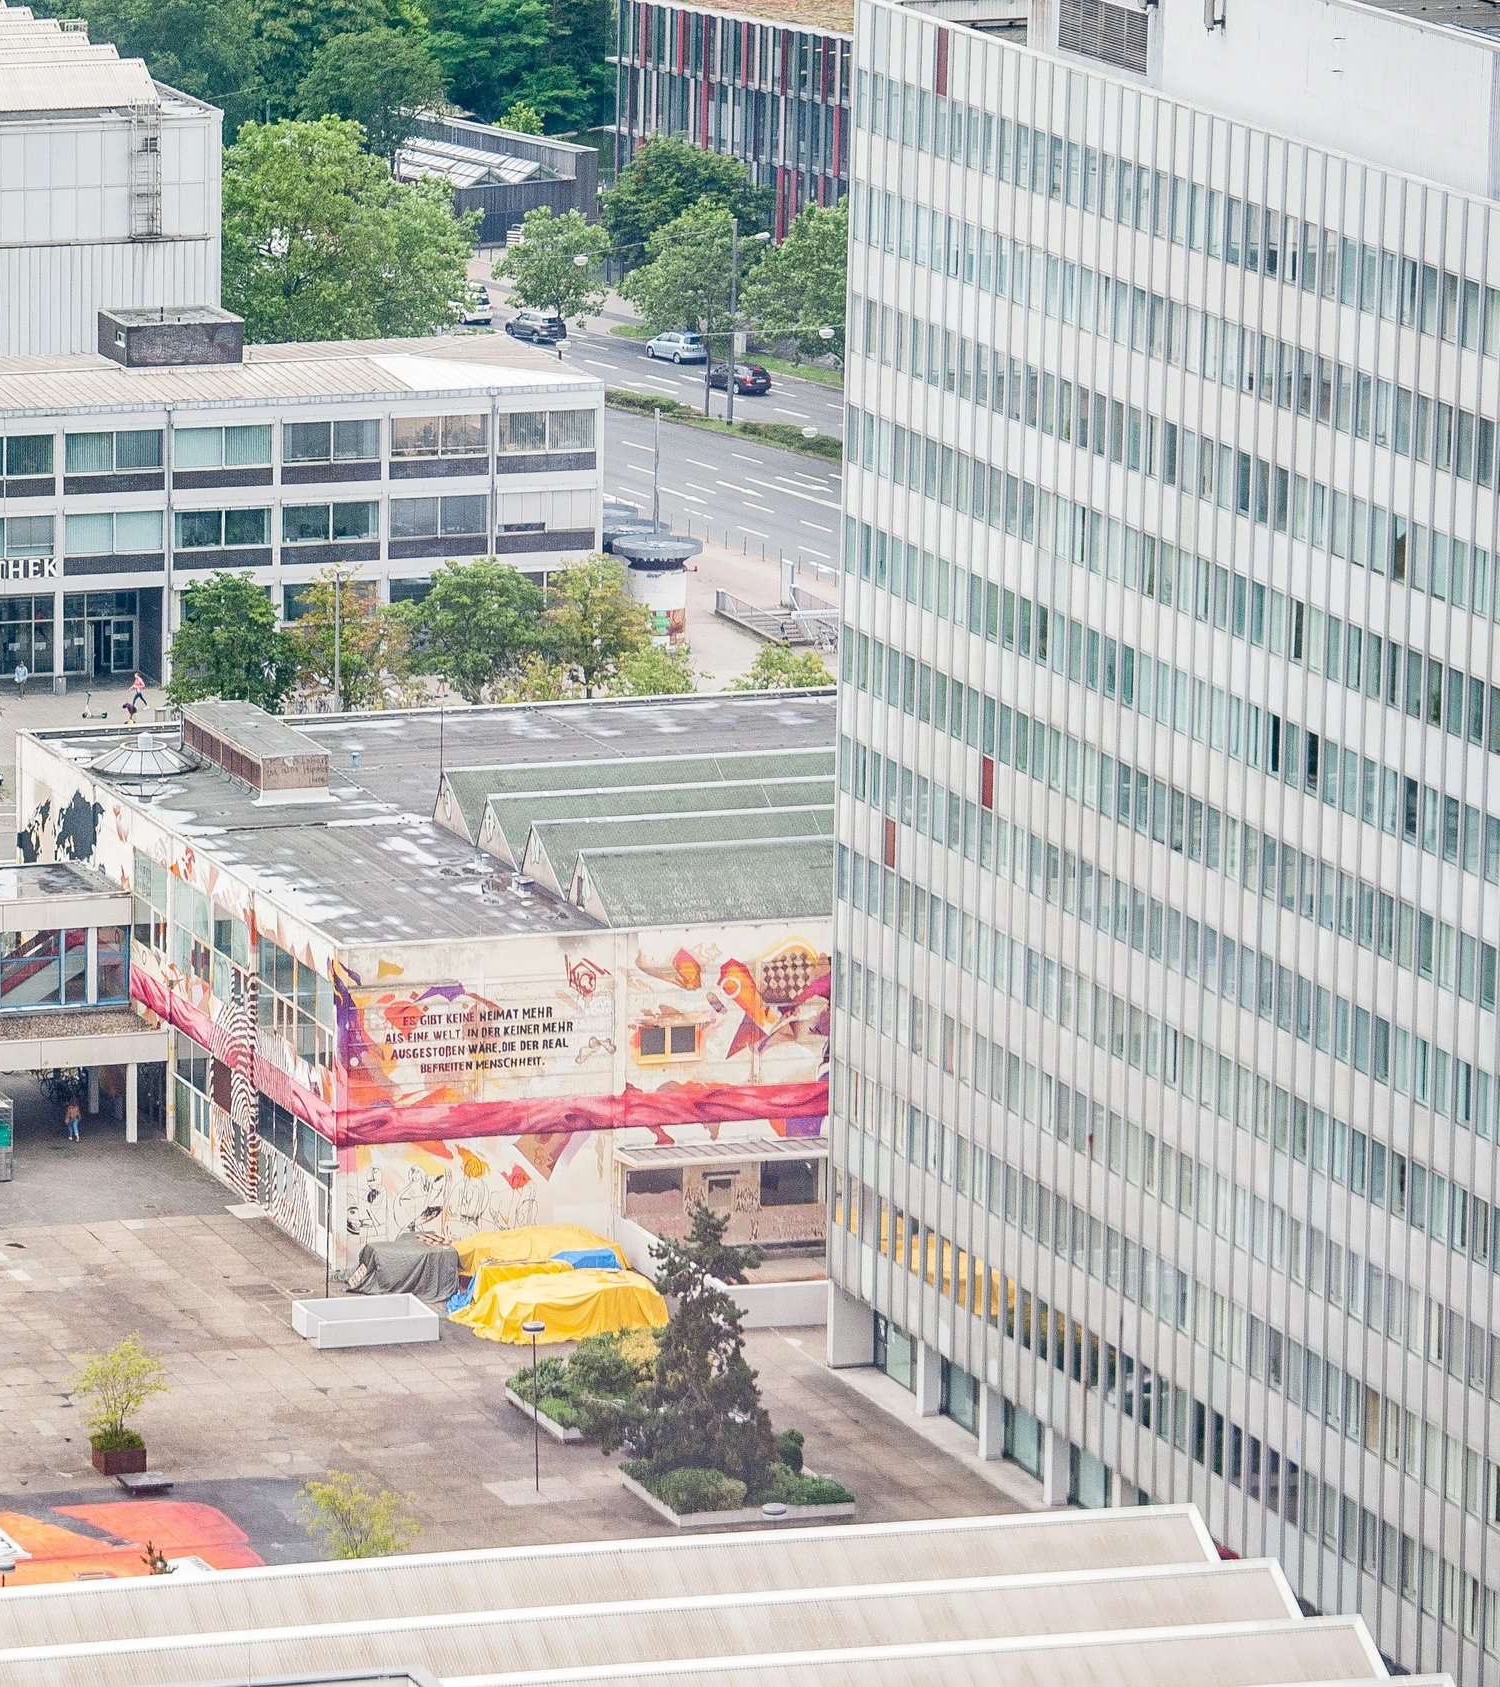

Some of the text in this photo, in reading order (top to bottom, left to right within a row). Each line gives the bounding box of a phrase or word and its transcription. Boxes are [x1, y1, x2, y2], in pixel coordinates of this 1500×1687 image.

[403, 1006, 553, 1026] ES GIBT KEINE HEIMAT MEHR
[467, 1028, 479, 1038] IN
[481, 1027, 500, 1038] DER
[503, 1023, 540, 1036] KEINER
[542, 1021, 574, 1034] MEHR
[520, 1040, 539, 1051] DER
[542, 1038, 569, 1050] REAL
[420, 1056, 545, 1074] BEFREITEN MENSCHHEIT.
